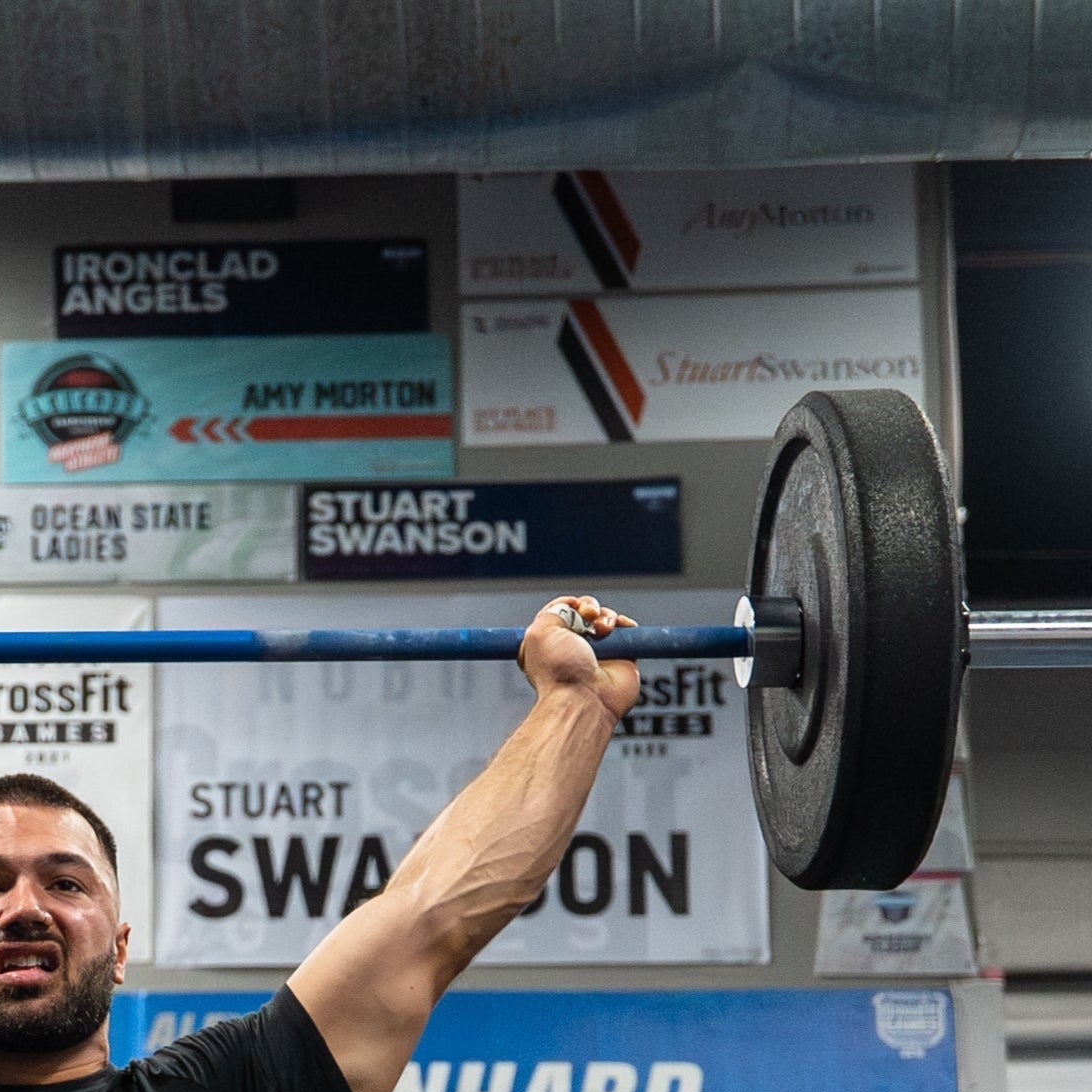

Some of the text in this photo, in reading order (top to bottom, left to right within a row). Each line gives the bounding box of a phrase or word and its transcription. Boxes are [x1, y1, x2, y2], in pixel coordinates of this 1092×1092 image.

[61, 249, 280, 284] IRONCLAD
[61, 283, 229, 316] ANGELS
[242, 379, 436, 410] AMY MORTON
[31, 504, 122, 532] OCEAN
[131, 502, 210, 531] STATE
[309, 490, 475, 523] STUART
[30, 534, 127, 562] LADIES
[309, 522, 527, 555] SWANSON
[613, 715, 704, 735] AMES
[191, 781, 351, 819] STUART
[188, 831, 692, 918] SWAON
